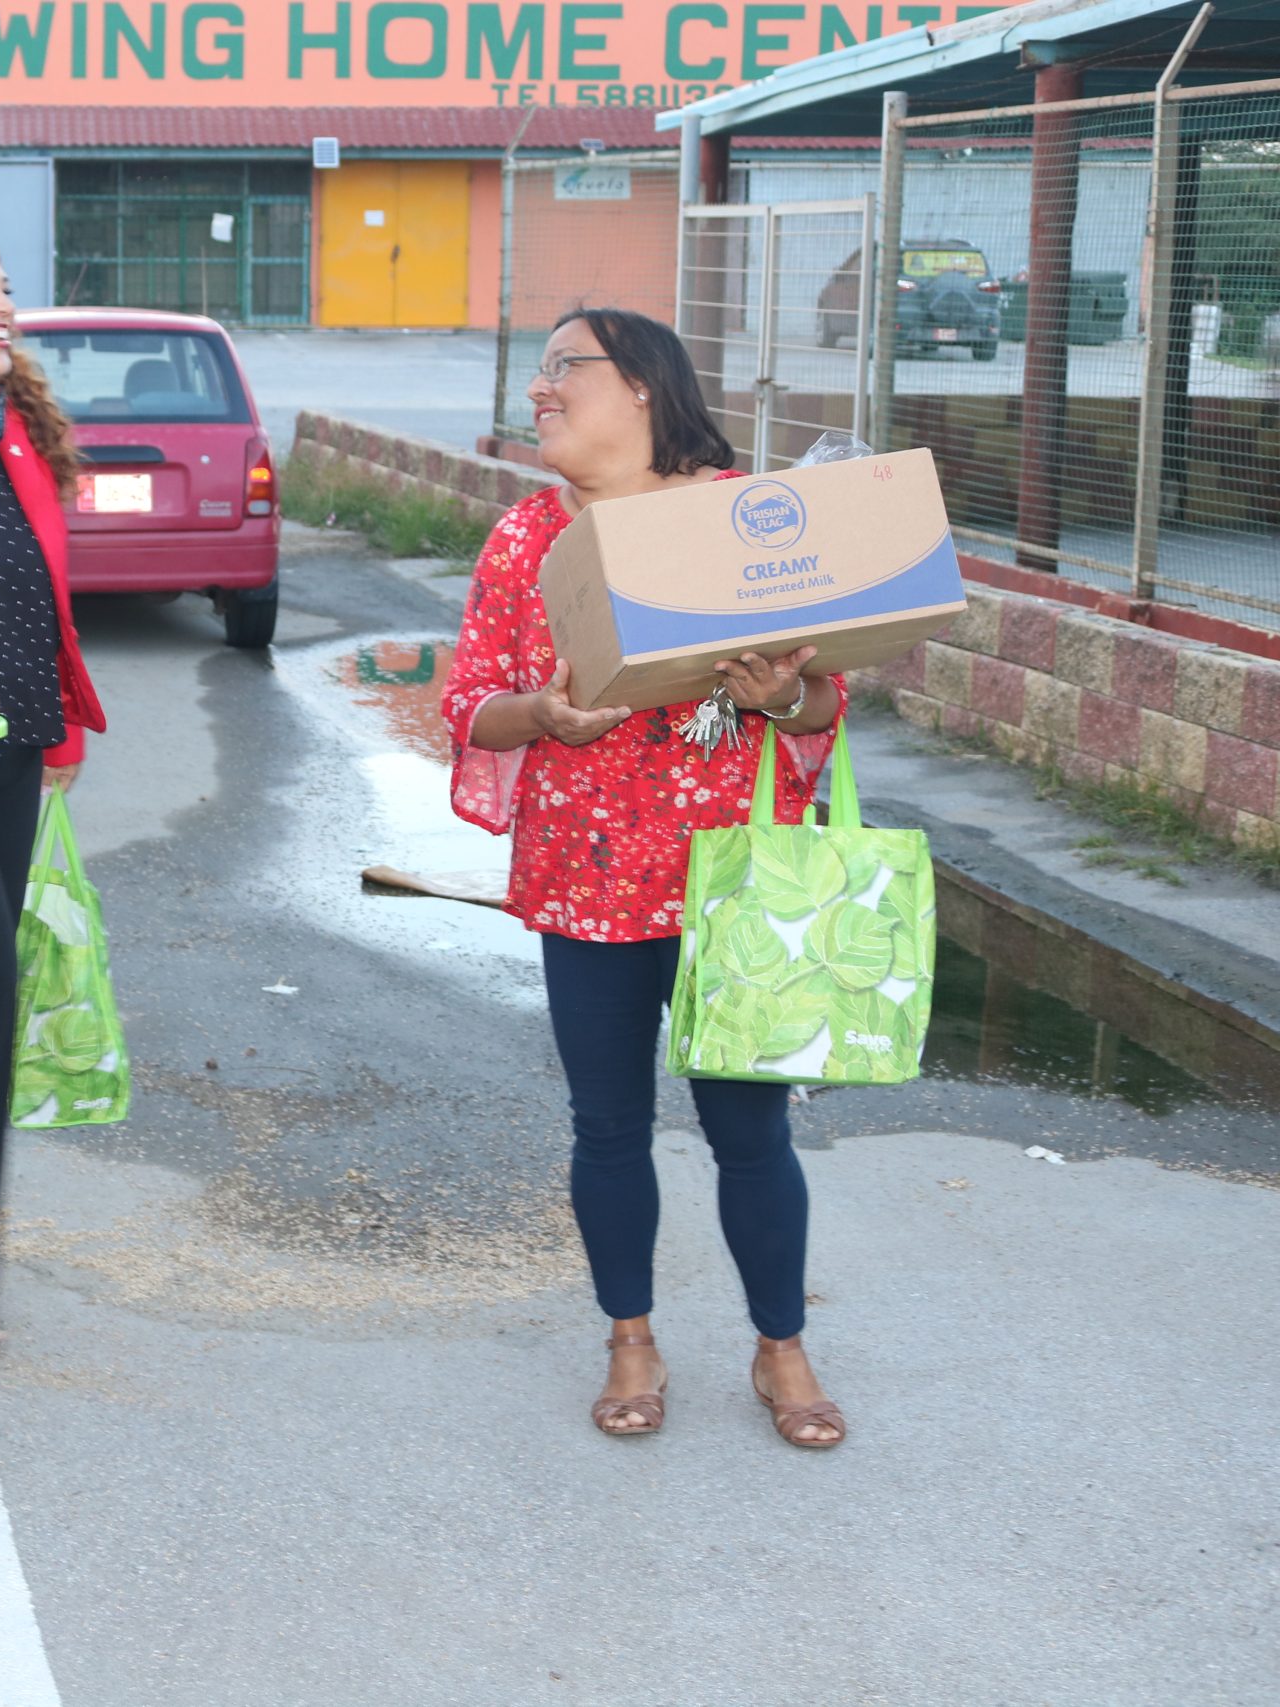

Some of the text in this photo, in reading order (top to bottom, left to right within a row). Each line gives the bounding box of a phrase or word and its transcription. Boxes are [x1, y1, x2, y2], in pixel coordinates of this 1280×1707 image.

[287, 2, 622, 80] HOME
[873, 464, 893, 482] 48
[747, 505, 790, 521] FRISIAN
[757, 517, 785, 530] FLAG
[742, 554, 819, 582] CREAMY
[736, 573, 836, 600] Evaporated Milk
